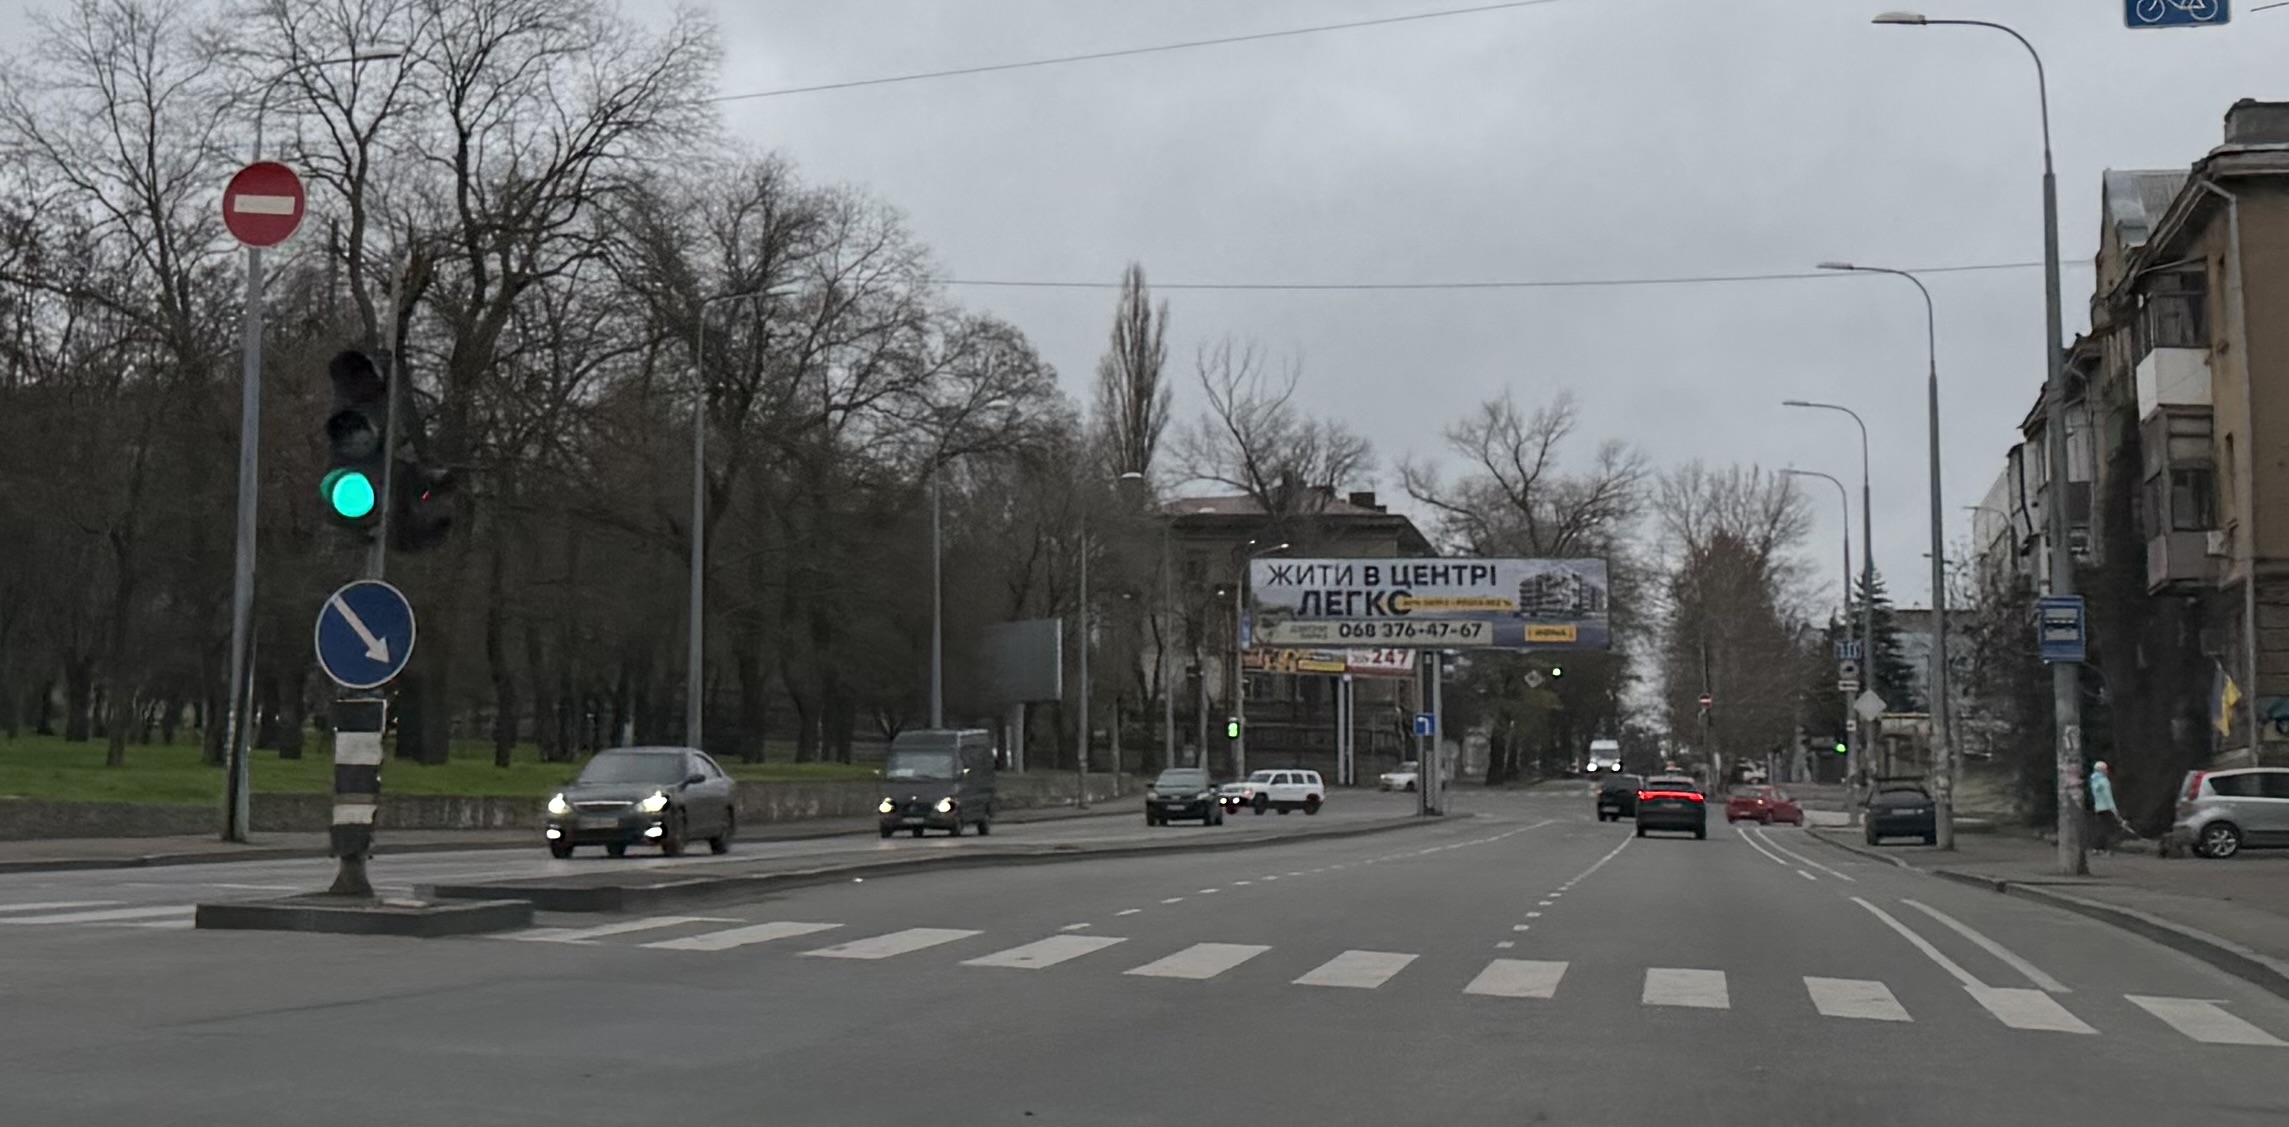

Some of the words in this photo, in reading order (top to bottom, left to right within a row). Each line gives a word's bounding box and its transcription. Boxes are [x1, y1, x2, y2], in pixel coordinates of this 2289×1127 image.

[1267, 564, 1353, 586] ЖИТИ
[1364, 565, 1380, 586] В
[1391, 565, 1497, 589] ЦЕНТРІ
[1339, 623, 1376, 638] 068
[1382, 622, 1482, 638] 376-47-67
